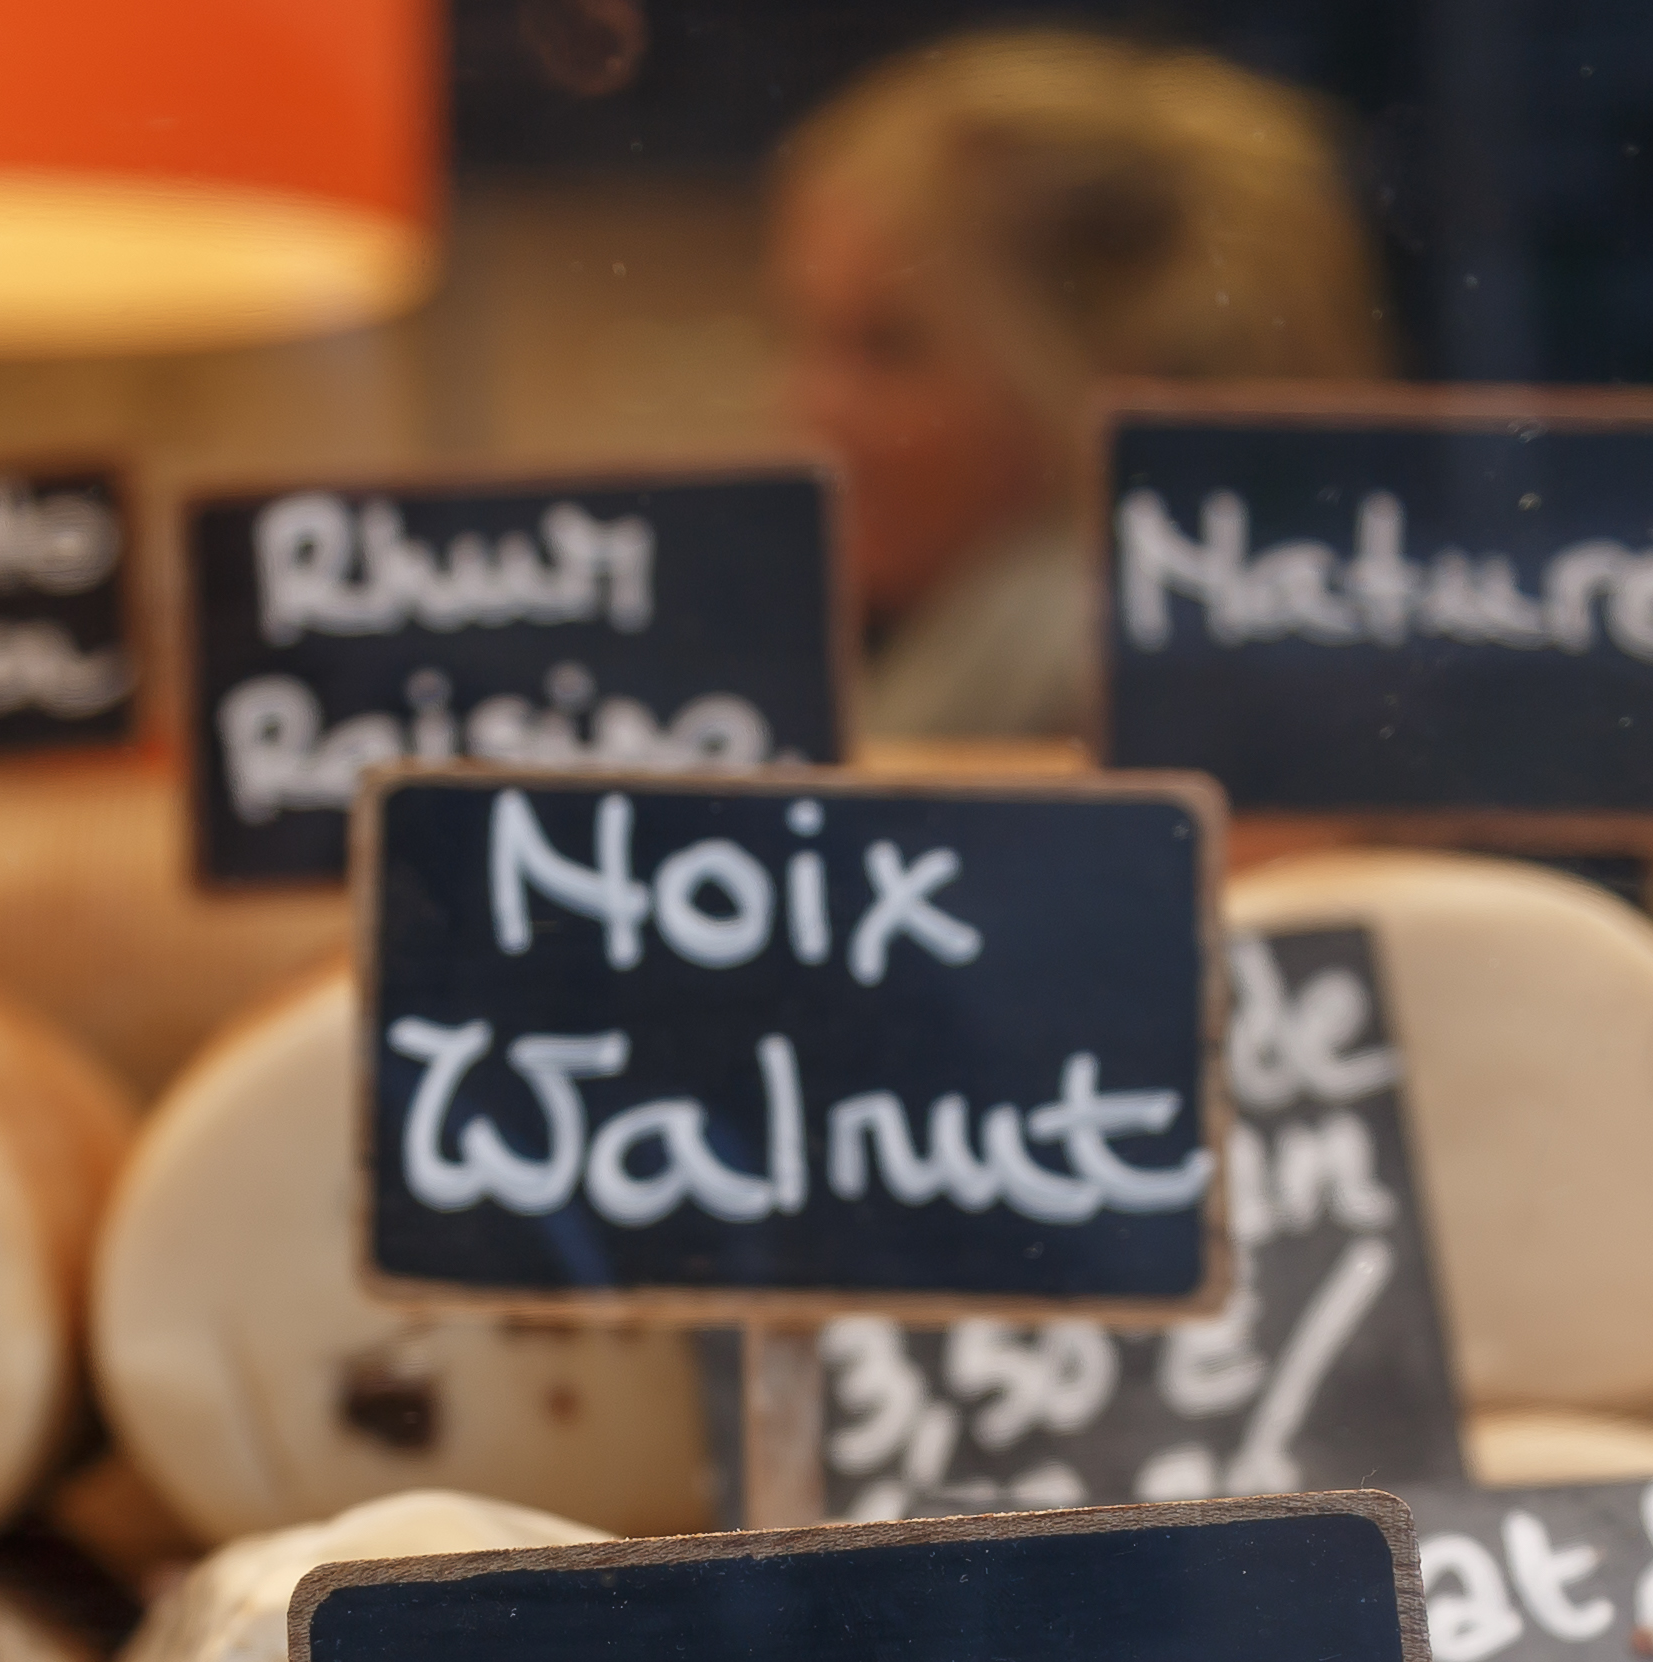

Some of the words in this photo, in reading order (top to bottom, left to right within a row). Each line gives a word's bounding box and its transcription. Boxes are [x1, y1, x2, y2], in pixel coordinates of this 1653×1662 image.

[254, 493, 655, 645] Rhum
[488, 787, 981, 984] Noix
[388, 1017, 1216, 1226] Walnut
